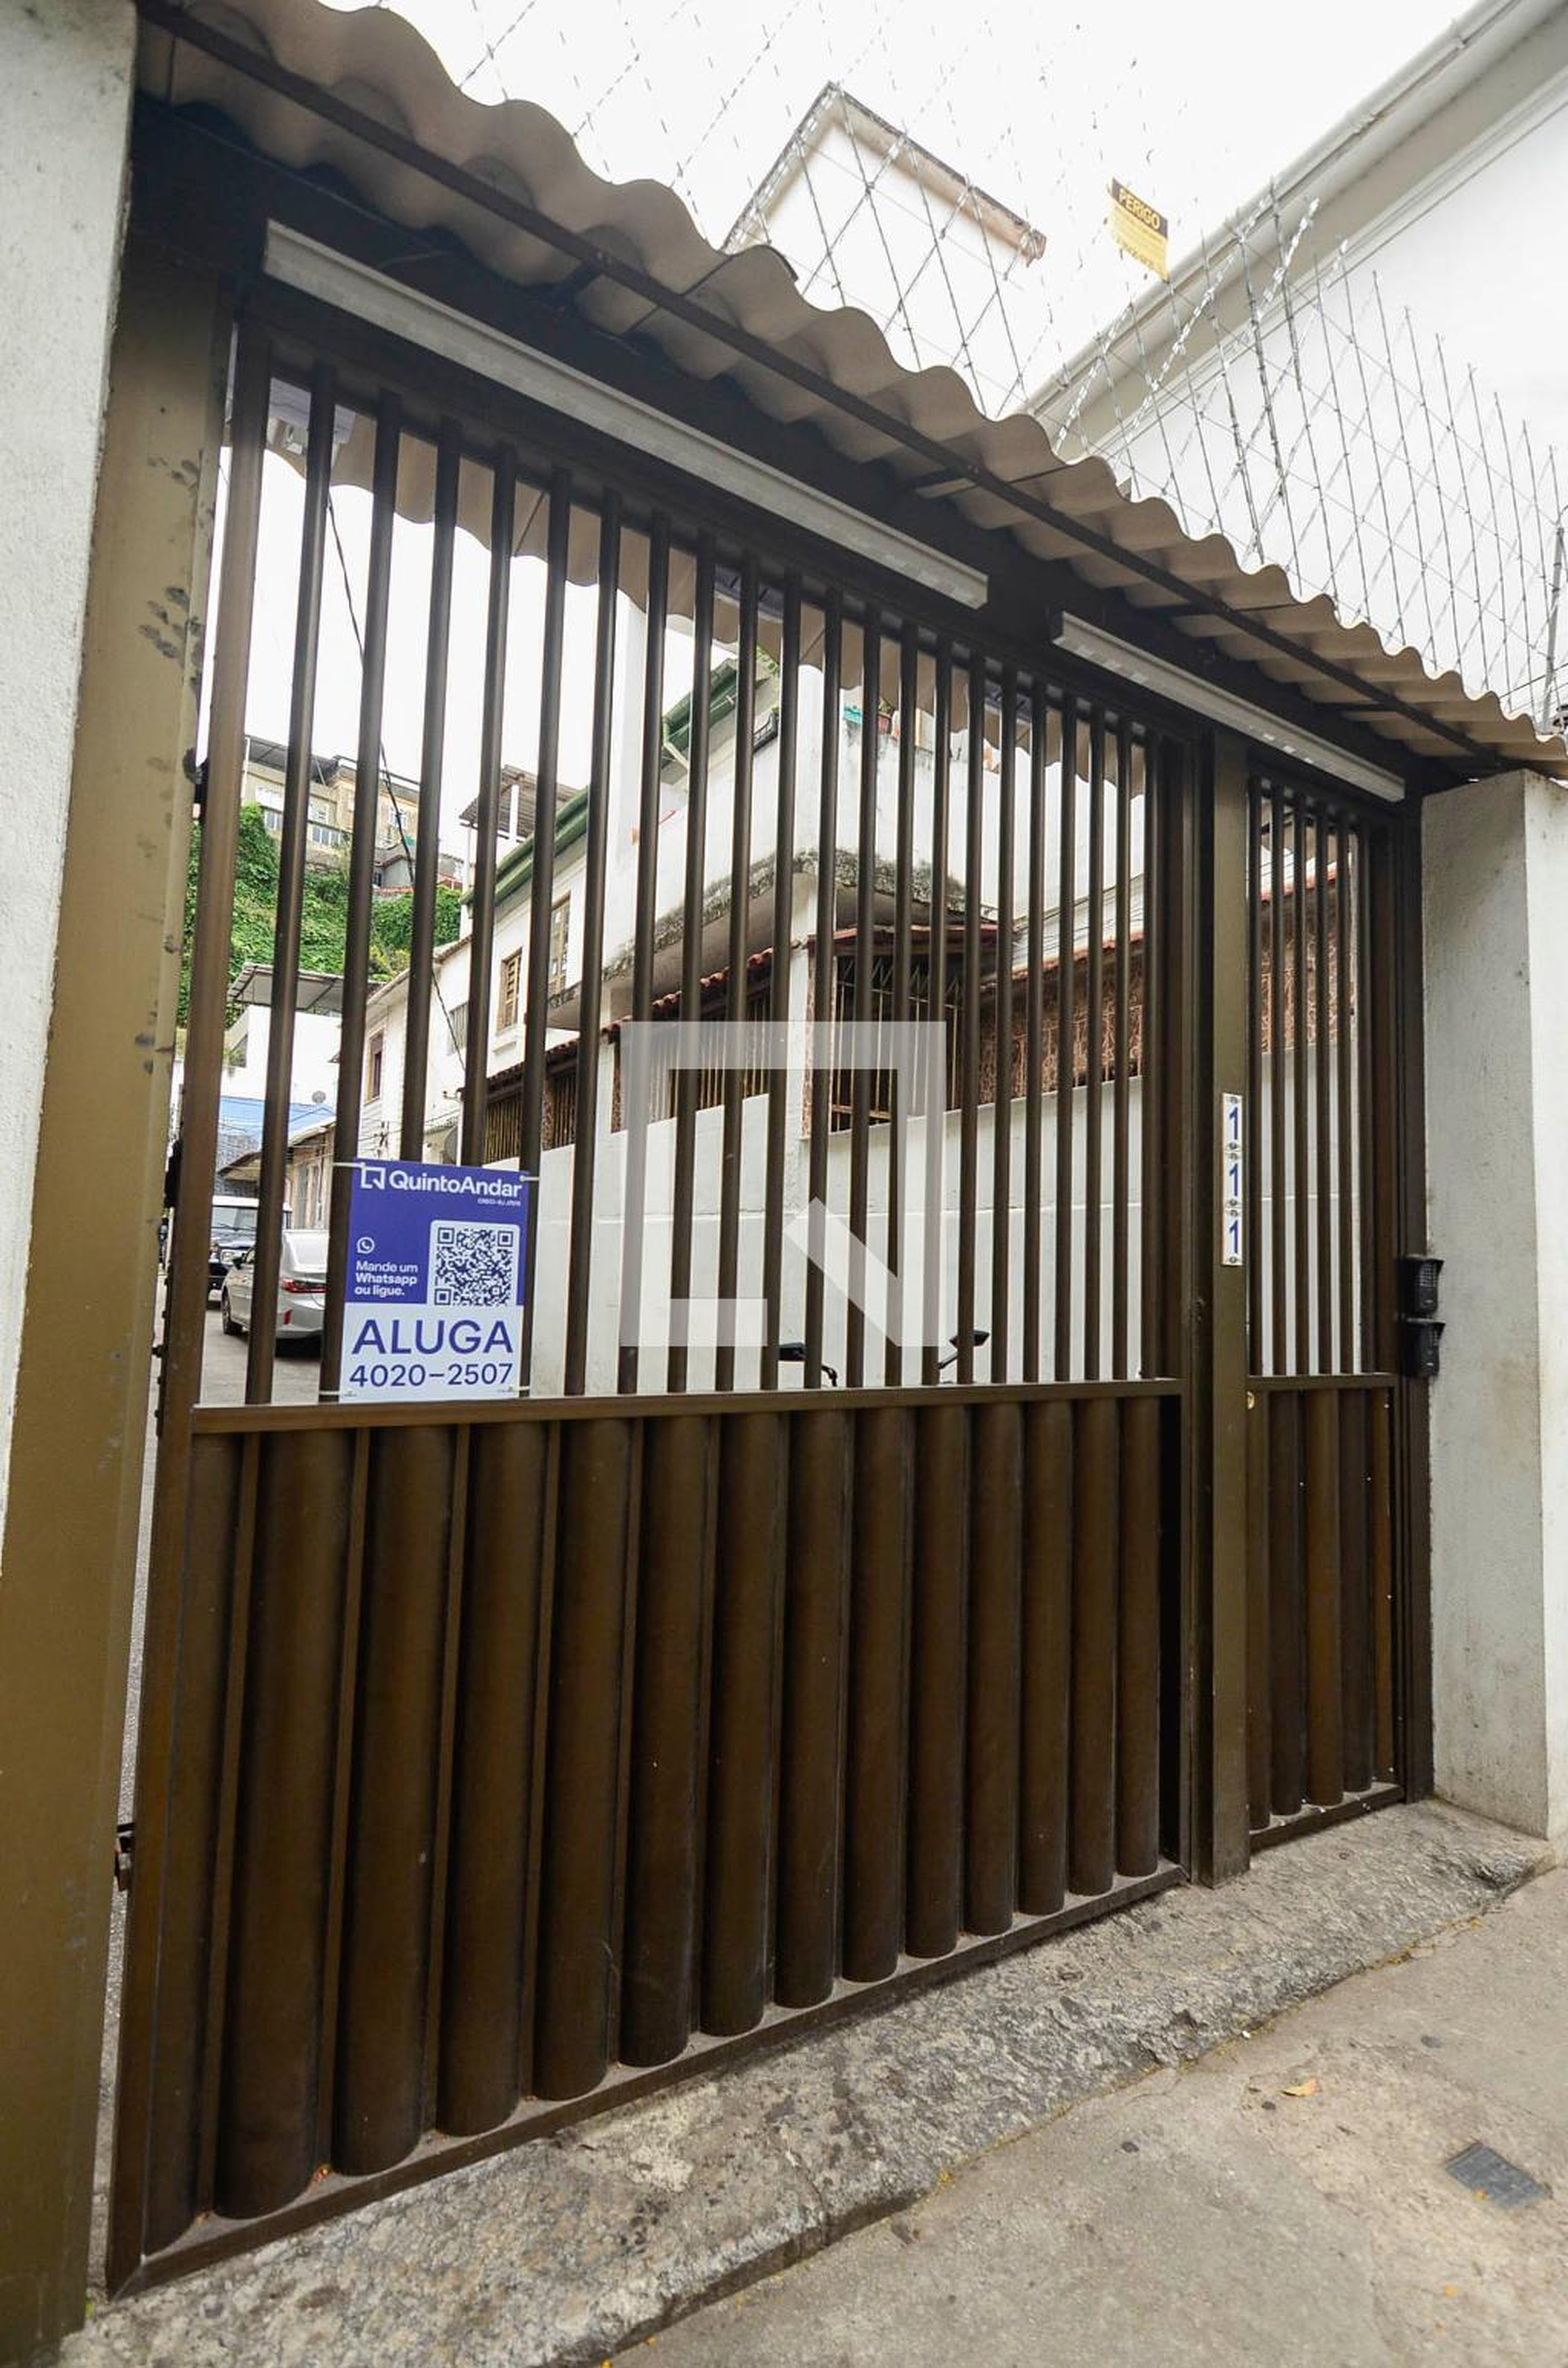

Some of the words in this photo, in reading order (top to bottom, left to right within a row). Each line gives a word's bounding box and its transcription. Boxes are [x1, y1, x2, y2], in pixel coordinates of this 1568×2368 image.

[1118, 187, 1160, 230] PERIGO
[389, 1170, 522, 1197] QuintoAndar
[355, 1272, 417, 1287] Whatsapp
[399, 1264, 418, 1273] um
[354, 1286, 371, 1295] ou
[372, 1284, 405, 1298] ligue.
[352, 1319, 514, 1354] ALUGA
[349, 1362, 513, 1387] 4020-2507
